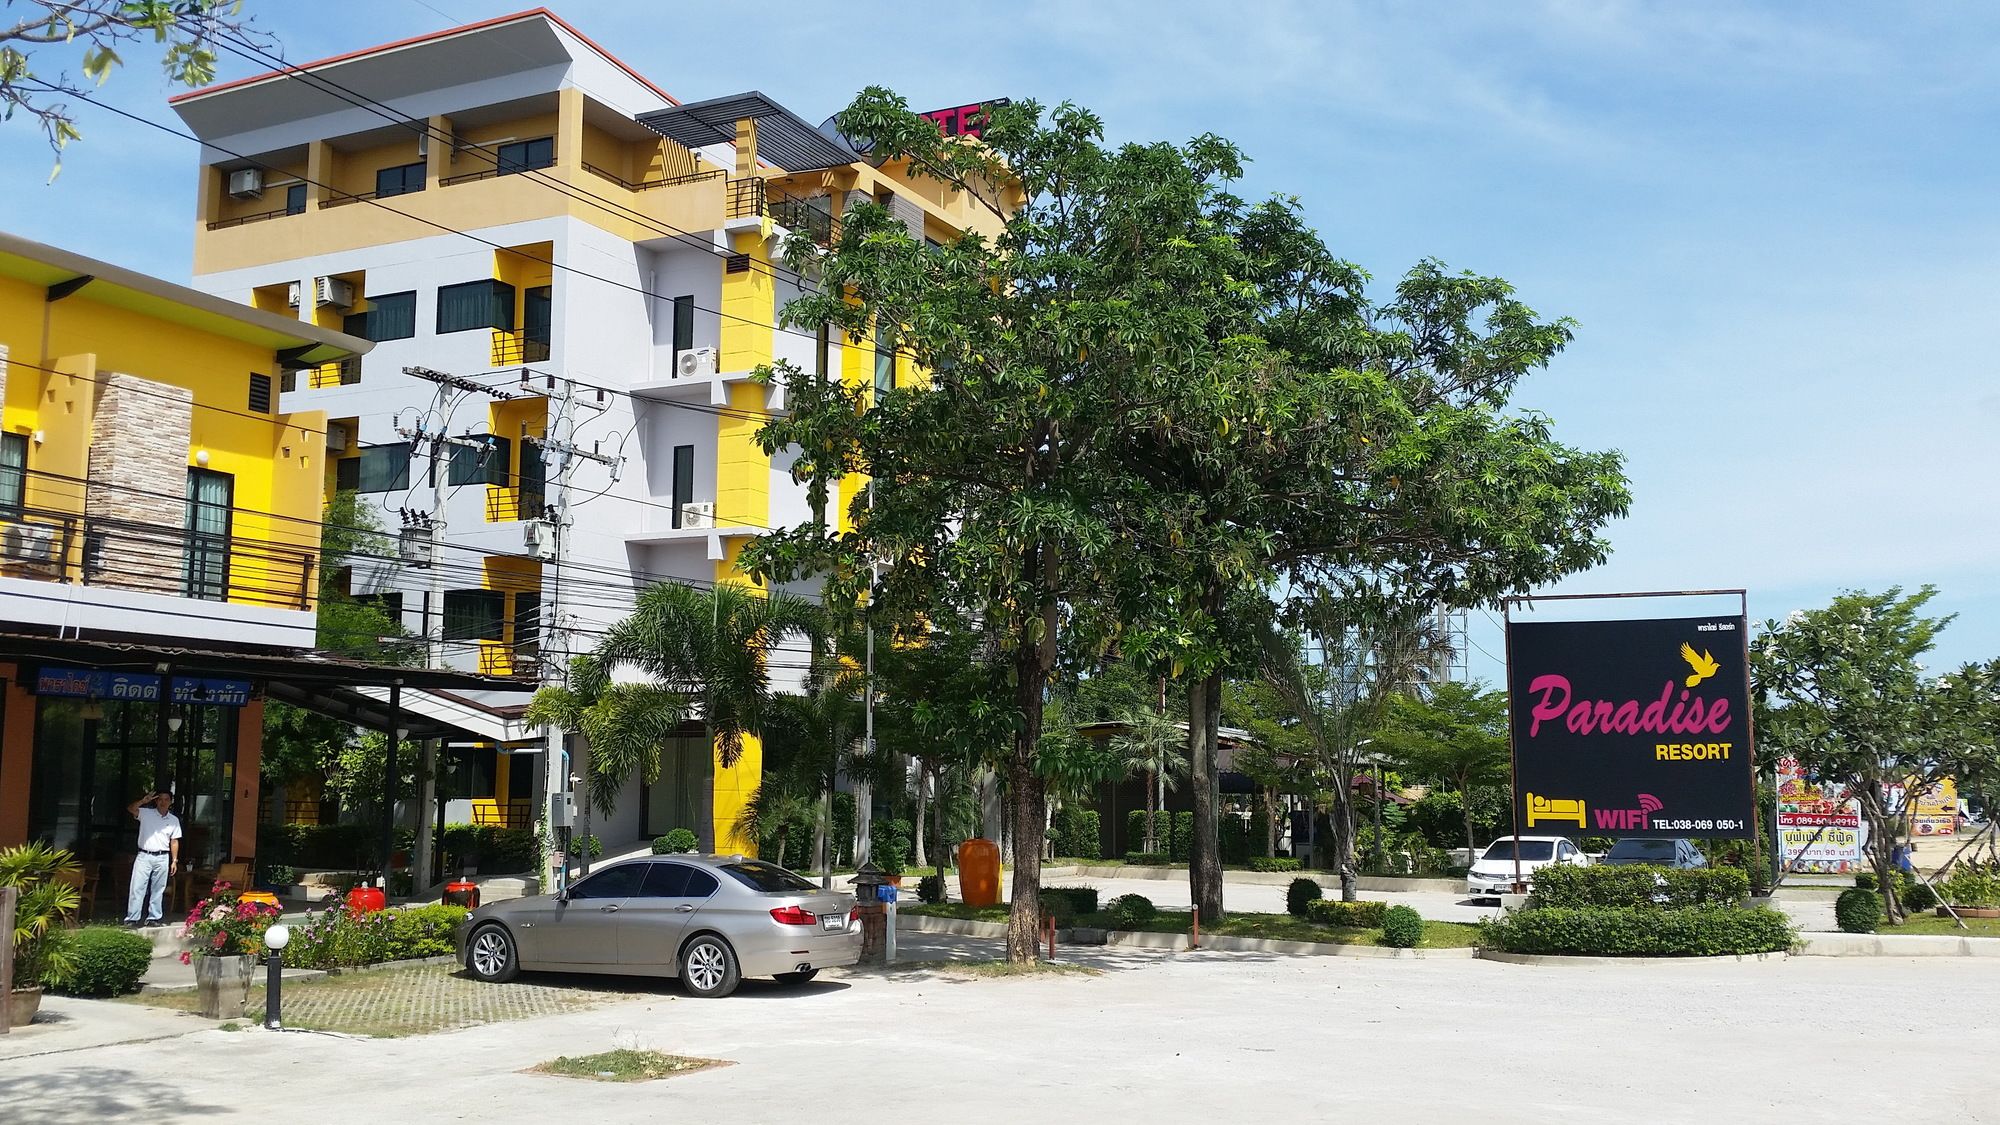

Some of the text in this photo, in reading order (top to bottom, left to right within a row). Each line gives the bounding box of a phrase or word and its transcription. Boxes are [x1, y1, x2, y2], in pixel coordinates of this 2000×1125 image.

[1529, 674, 1732, 738] Paradise
[1656, 743, 1732, 761] RESORT
[1653, 819, 1744, 830] TEL:038-069 050-1
